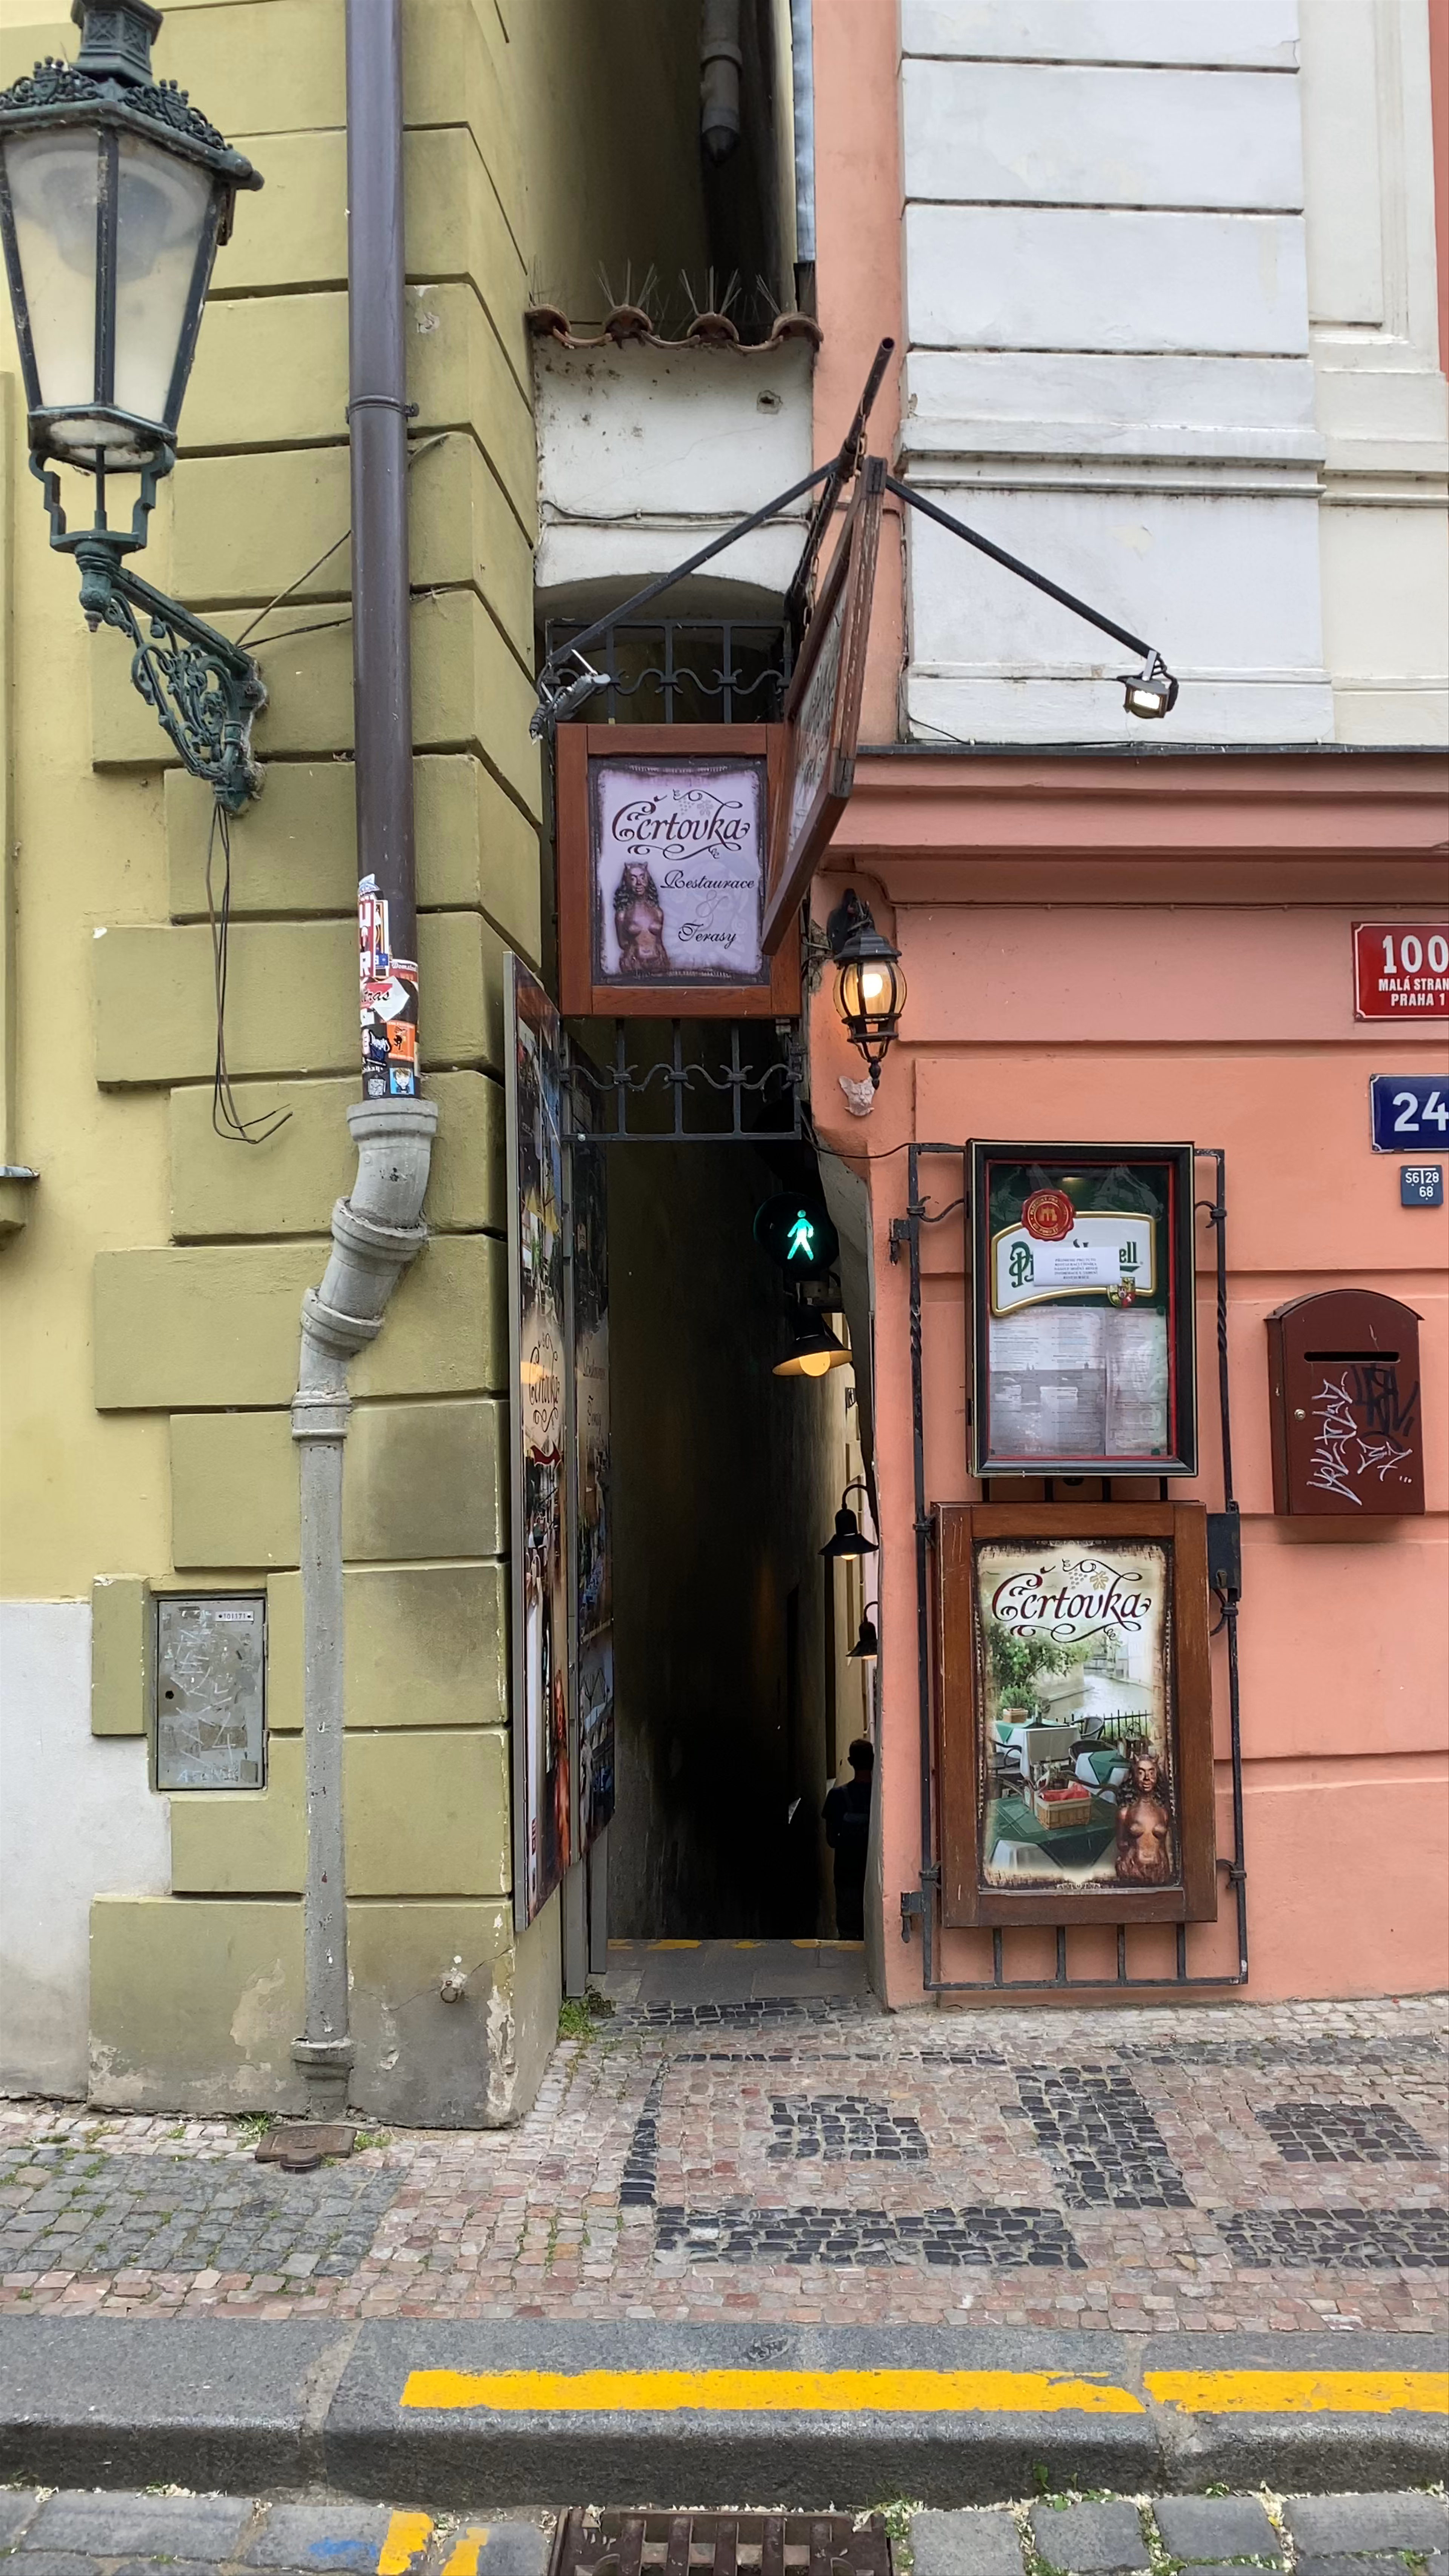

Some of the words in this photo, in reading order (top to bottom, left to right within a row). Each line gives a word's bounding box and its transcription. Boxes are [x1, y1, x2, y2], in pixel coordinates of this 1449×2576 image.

[612, 795, 750, 849] Čertovka
[661, 870, 754, 889] Restaurace
[678, 922, 737, 949] Terasy
[1382, 935, 1449, 973] 100
[1378, 975, 1411, 991] MALÁ
[1391, 993, 1434, 1006] PRAHA
[1439, 993, 1445, 1006] 1
[1392, 1091, 1449, 1131] 24
[1419, 1186, 1433, 1197] 68
[992, 1566, 1151, 1631] Čertovka
